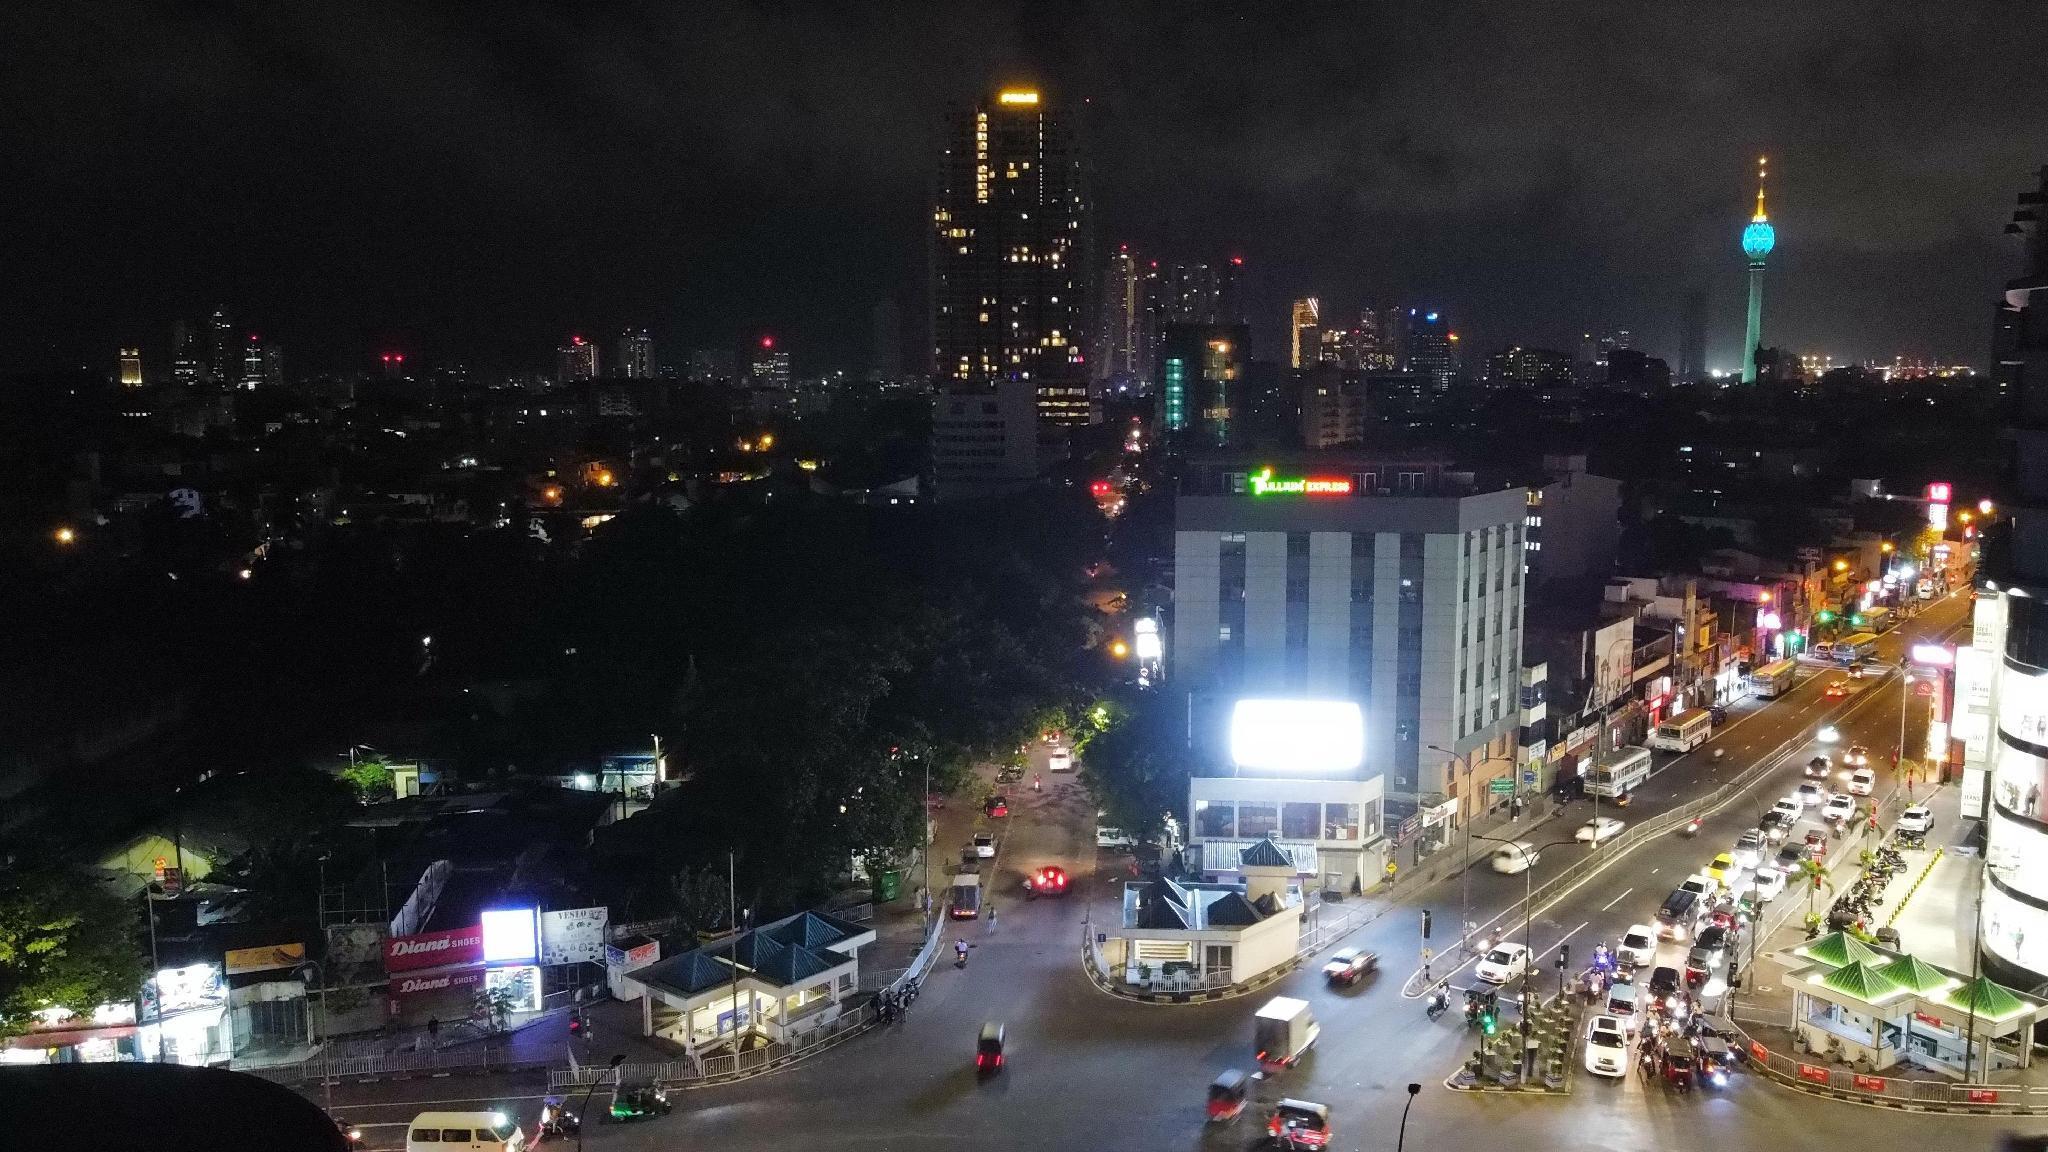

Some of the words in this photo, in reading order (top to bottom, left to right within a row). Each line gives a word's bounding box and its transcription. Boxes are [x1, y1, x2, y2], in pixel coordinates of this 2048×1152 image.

[390, 935, 451, 957] Diana
[451, 936, 481, 948] SHOES
[399, 976, 451, 993] Diana
[453, 974, 479, 985] SHOES
